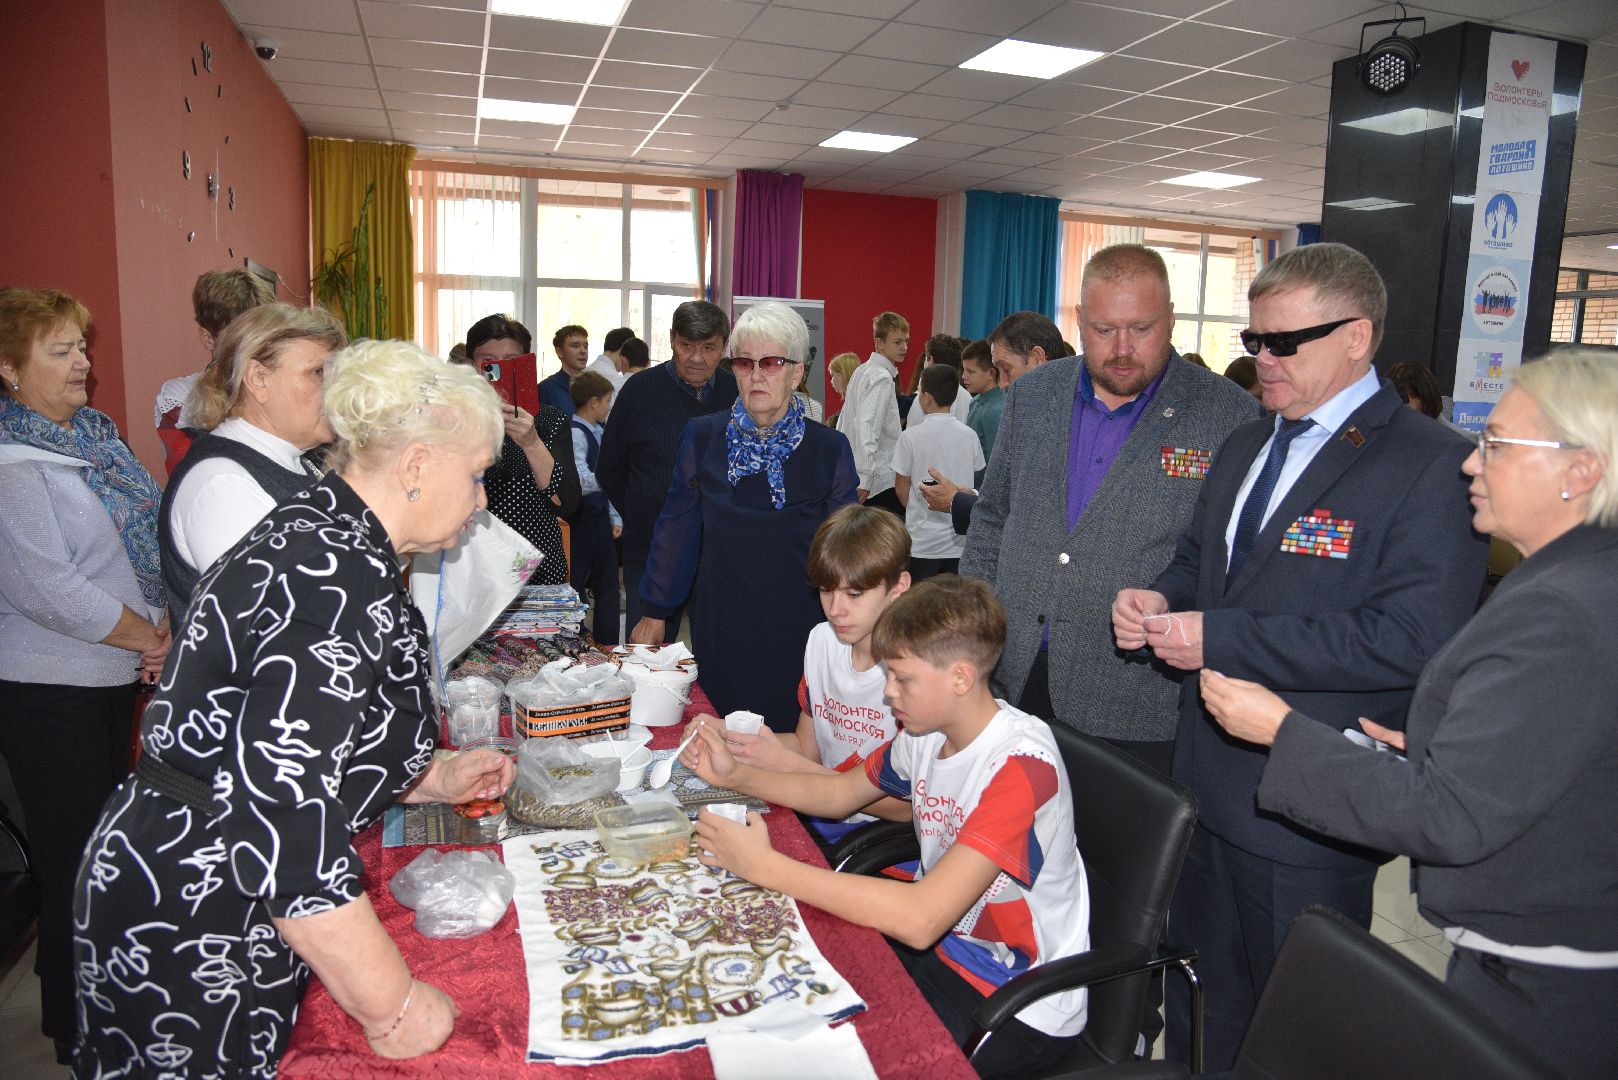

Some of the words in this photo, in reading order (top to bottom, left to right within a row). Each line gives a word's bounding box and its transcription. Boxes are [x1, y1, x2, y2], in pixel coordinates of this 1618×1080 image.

[1494, 82, 1543, 98] ВОЛОНТЕРЫ
[1488, 91, 1547, 108] ПОДМОСКОВЬЯ
[1458, 412, 1487, 425] Движ
